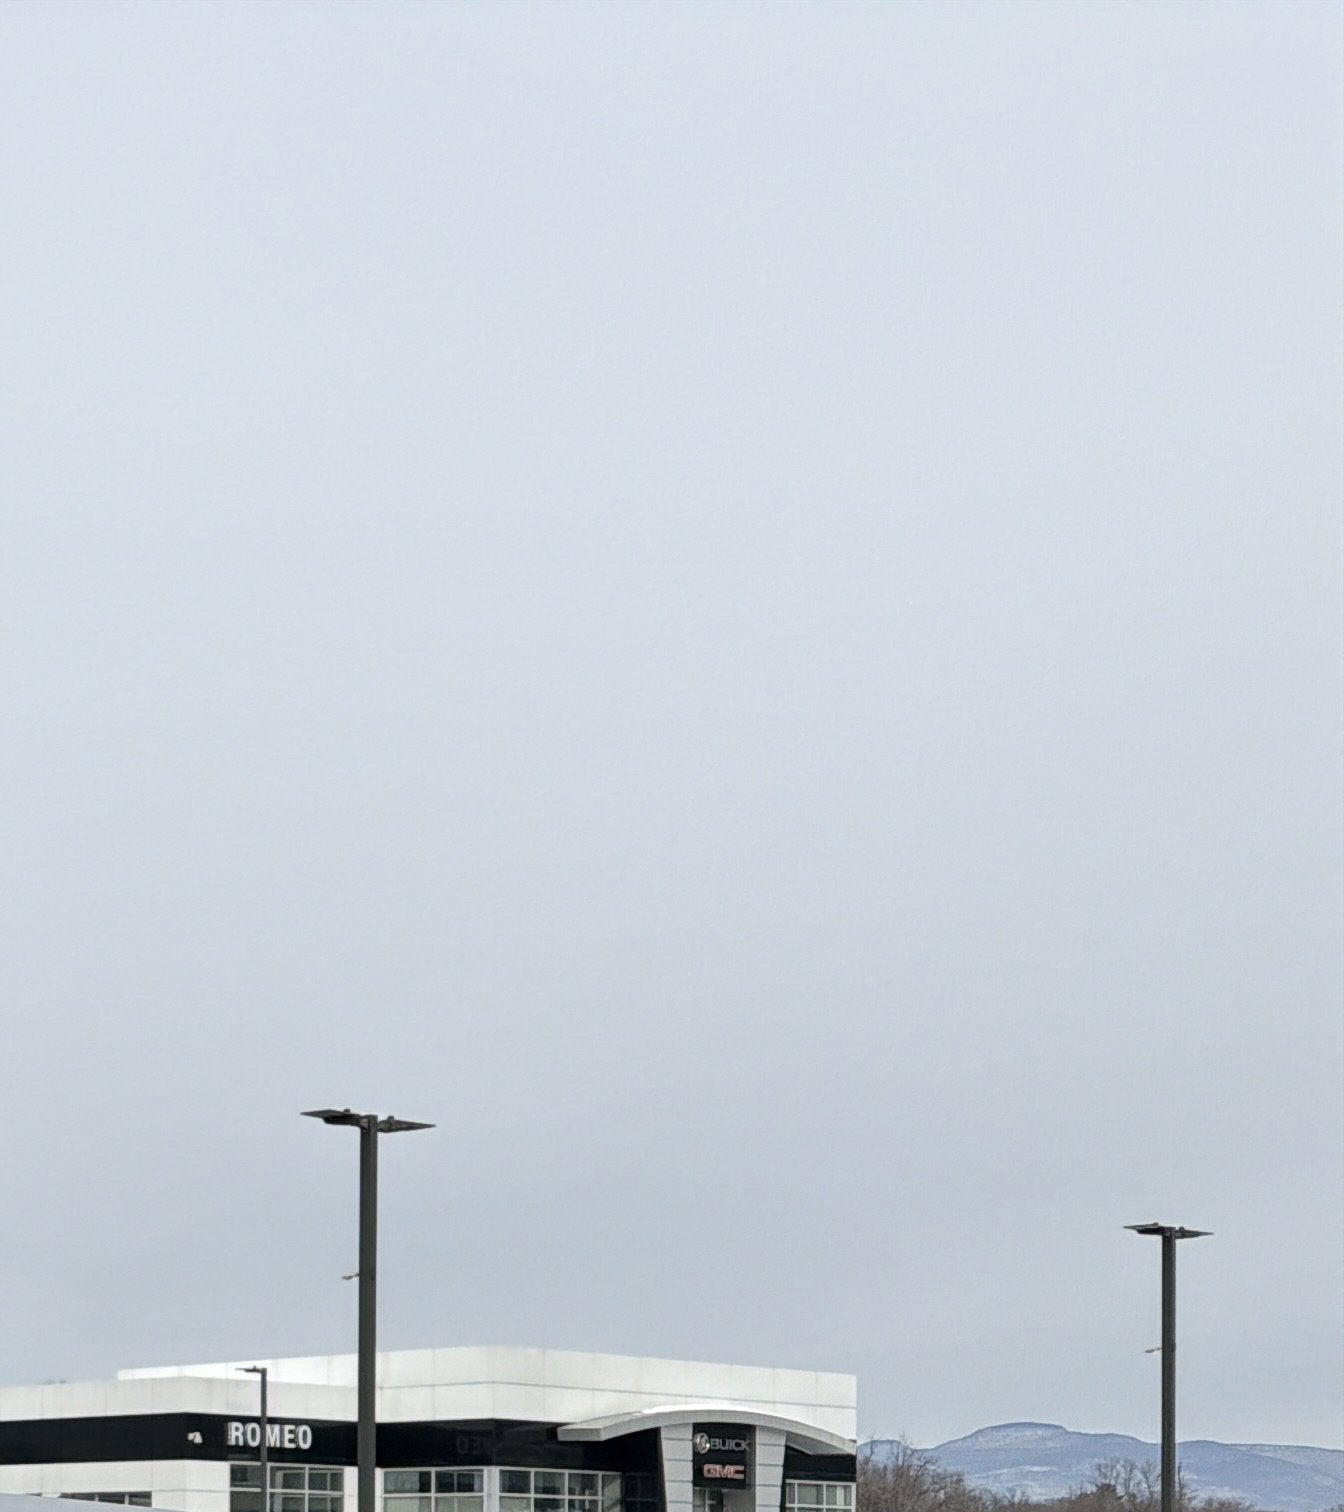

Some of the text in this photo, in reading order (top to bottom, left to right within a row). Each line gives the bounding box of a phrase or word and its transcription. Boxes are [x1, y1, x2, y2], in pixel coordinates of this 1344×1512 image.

[227, 1421, 312, 1450] ROMEO
[710, 1438, 750, 1451] BUICK
[703, 1463, 745, 1479] GMC
